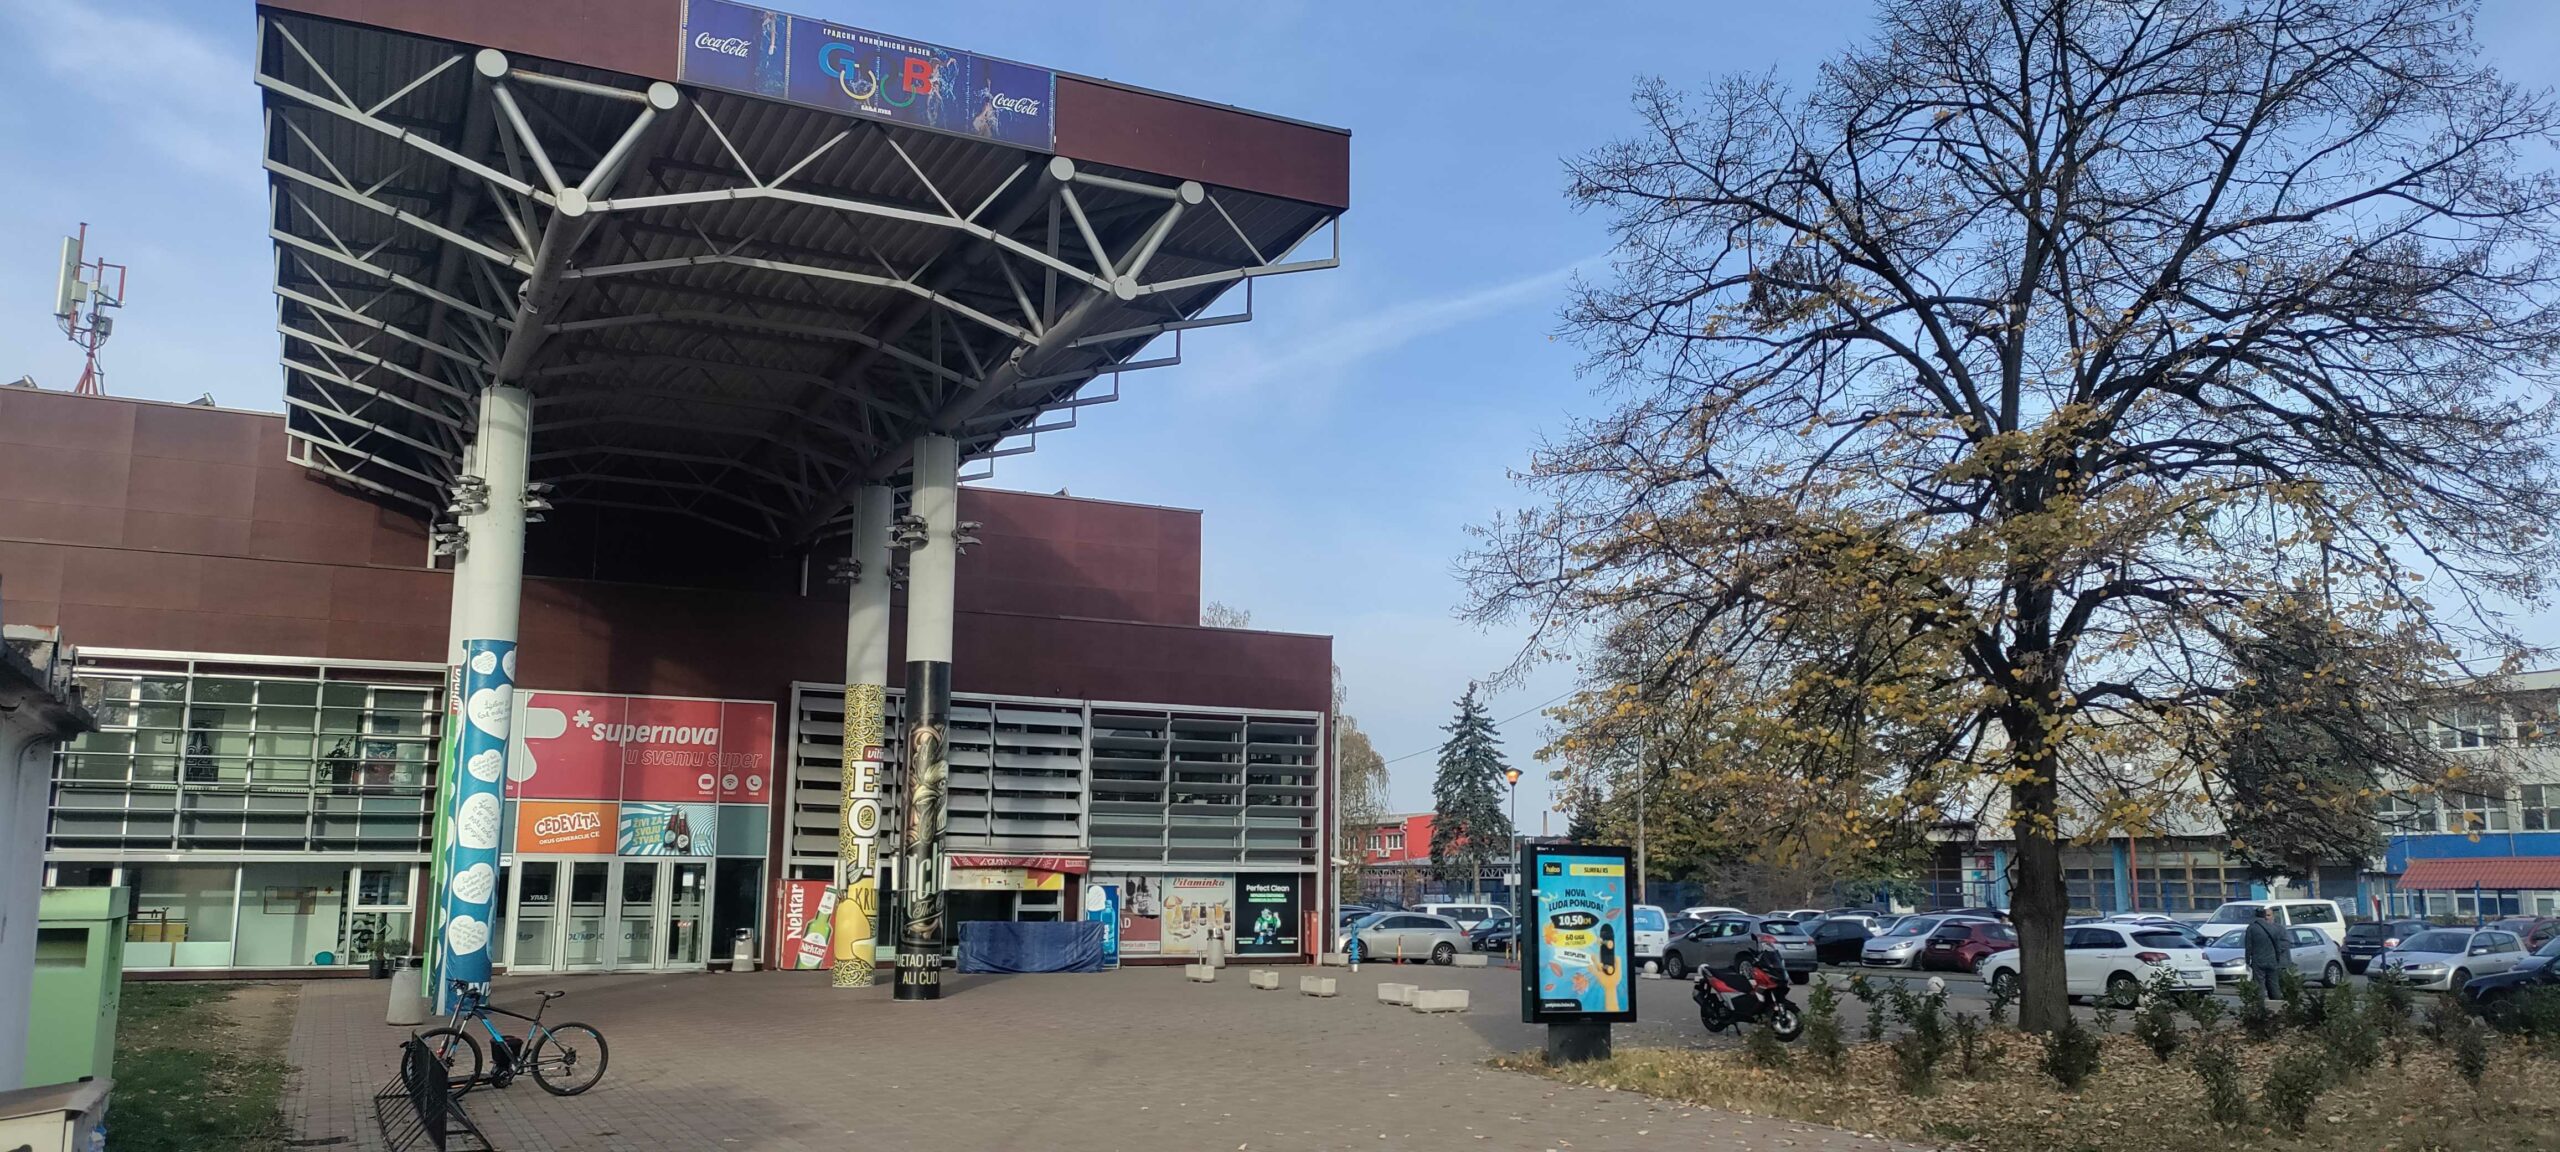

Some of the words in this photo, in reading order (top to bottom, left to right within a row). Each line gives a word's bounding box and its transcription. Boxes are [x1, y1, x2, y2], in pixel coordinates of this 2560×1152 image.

[591, 723, 719, 747] supernova
[641, 751, 704, 767] svemu
[707, 752, 762, 771] super
[535, 812, 600, 836] CEDEVITA
[651, 815, 663, 826] ZA
[1173, 878, 1225, 887] Vitaminka
[1246, 884, 1270, 892] Perfect
[1270, 884, 1290, 892] Clean
[1564, 888, 1587, 898] NOVA
[786, 884, 804, 941] Nektar
[1548, 900, 1569, 912] LUDA
[1569, 899, 1604, 912] PONUDA!
[800, 941, 826, 956] Nektar
[902, 971, 917, 985] ALI
